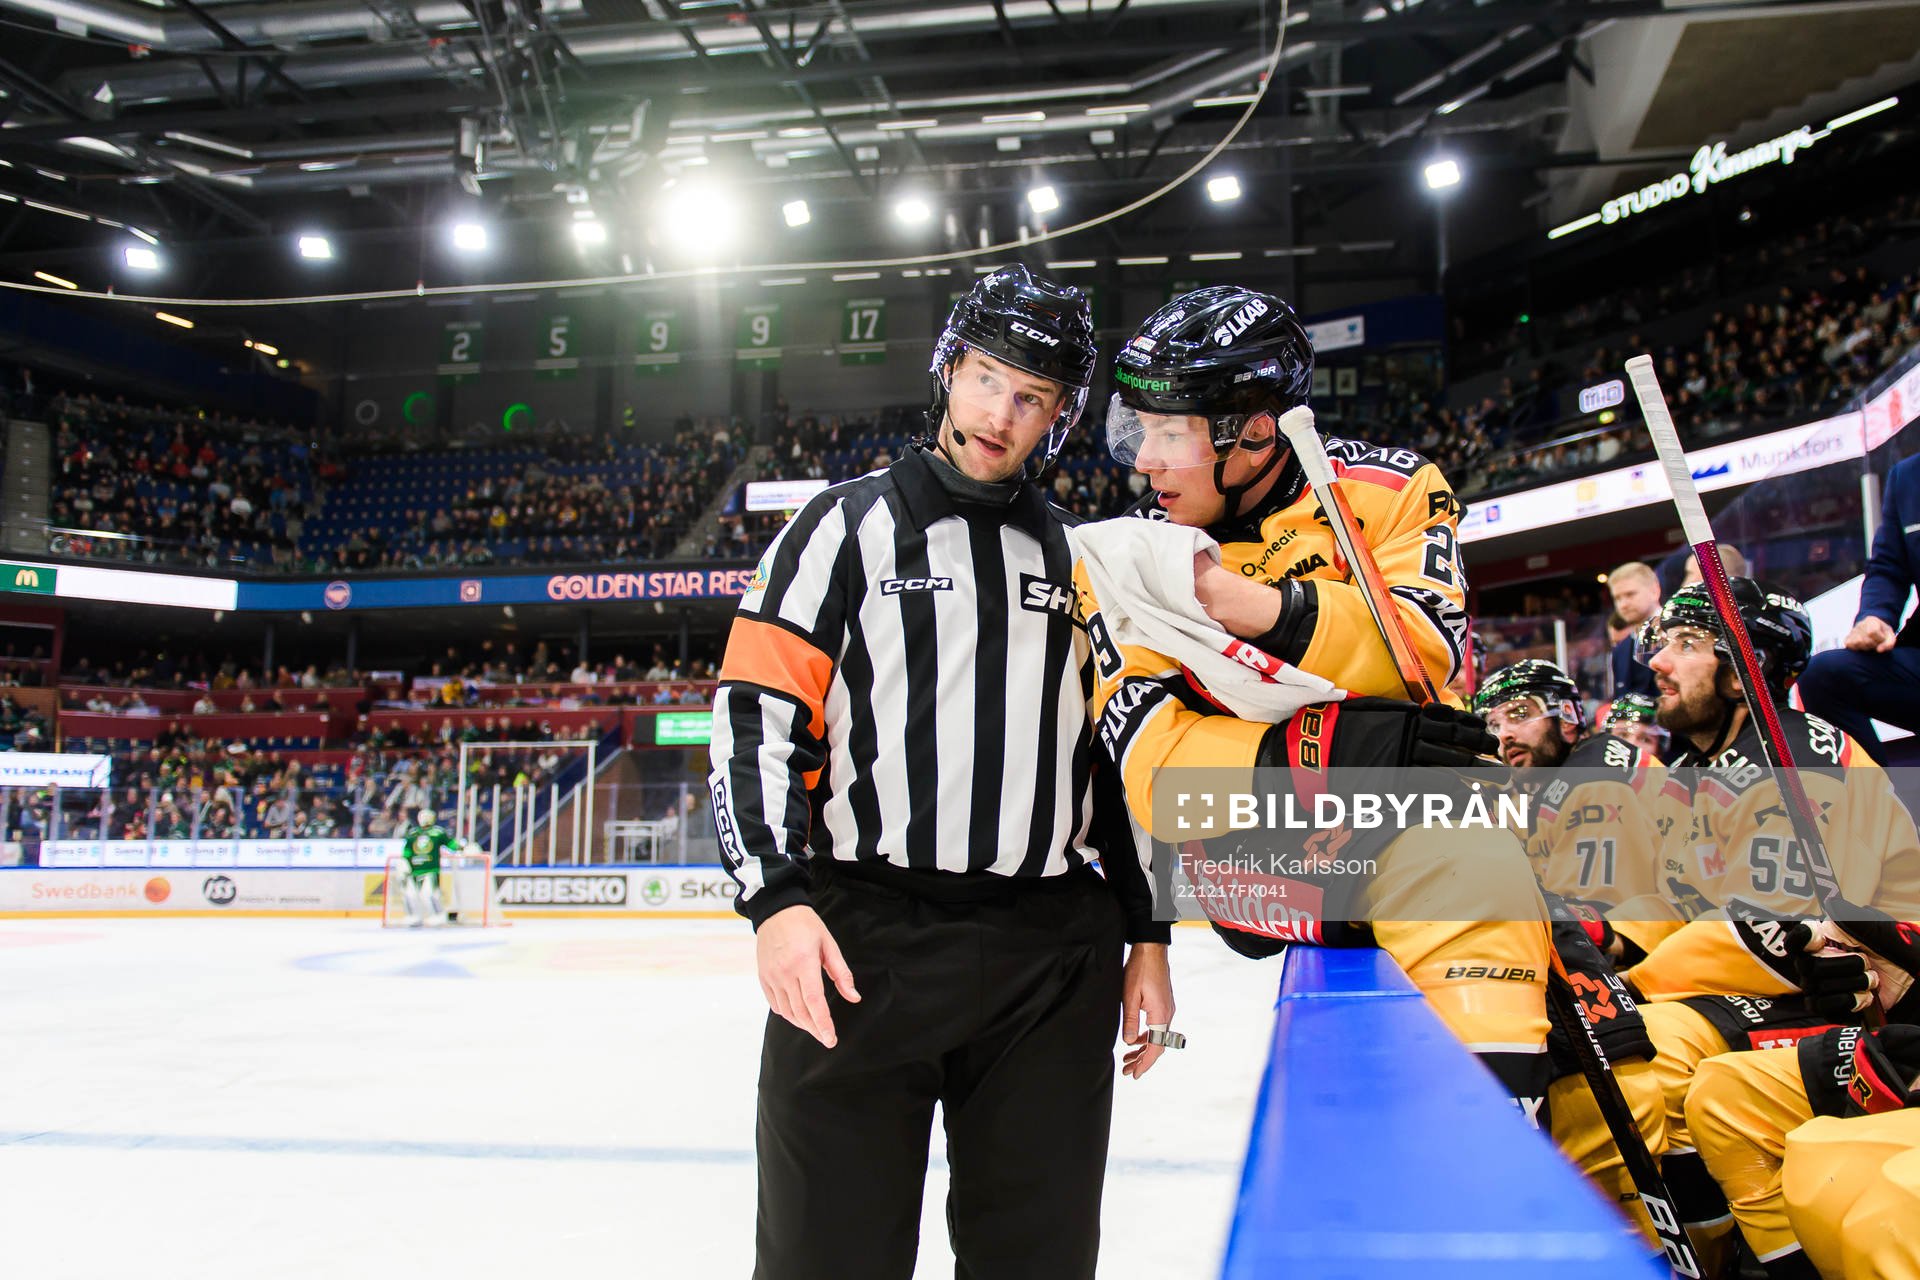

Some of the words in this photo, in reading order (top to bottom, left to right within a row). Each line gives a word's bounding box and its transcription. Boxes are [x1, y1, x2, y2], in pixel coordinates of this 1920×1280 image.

[1601, 173, 1690, 225] STUDIO
[751, 316, 770, 345] 9
[849, 309, 879, 340] 17
[1228, 298, 1269, 337] LKAB
[452, 332, 471, 362] 2
[550, 327, 568, 357] 5
[651, 321, 668, 351] 9
[1010, 321, 1059, 347] CCM
[547, 575, 645, 600] GOLDEN
[649, 571, 704, 598] STAR
[883, 577, 950, 595] CCM
[713, 786, 740, 866] CCM
[1576, 838, 1616, 888] 71
[31, 882, 137, 900] Swedbank
[497, 876, 627, 903] ARBESKO
[1445, 966, 1536, 982] BAUER
[1573, 1003, 1611, 1071] BAUER
